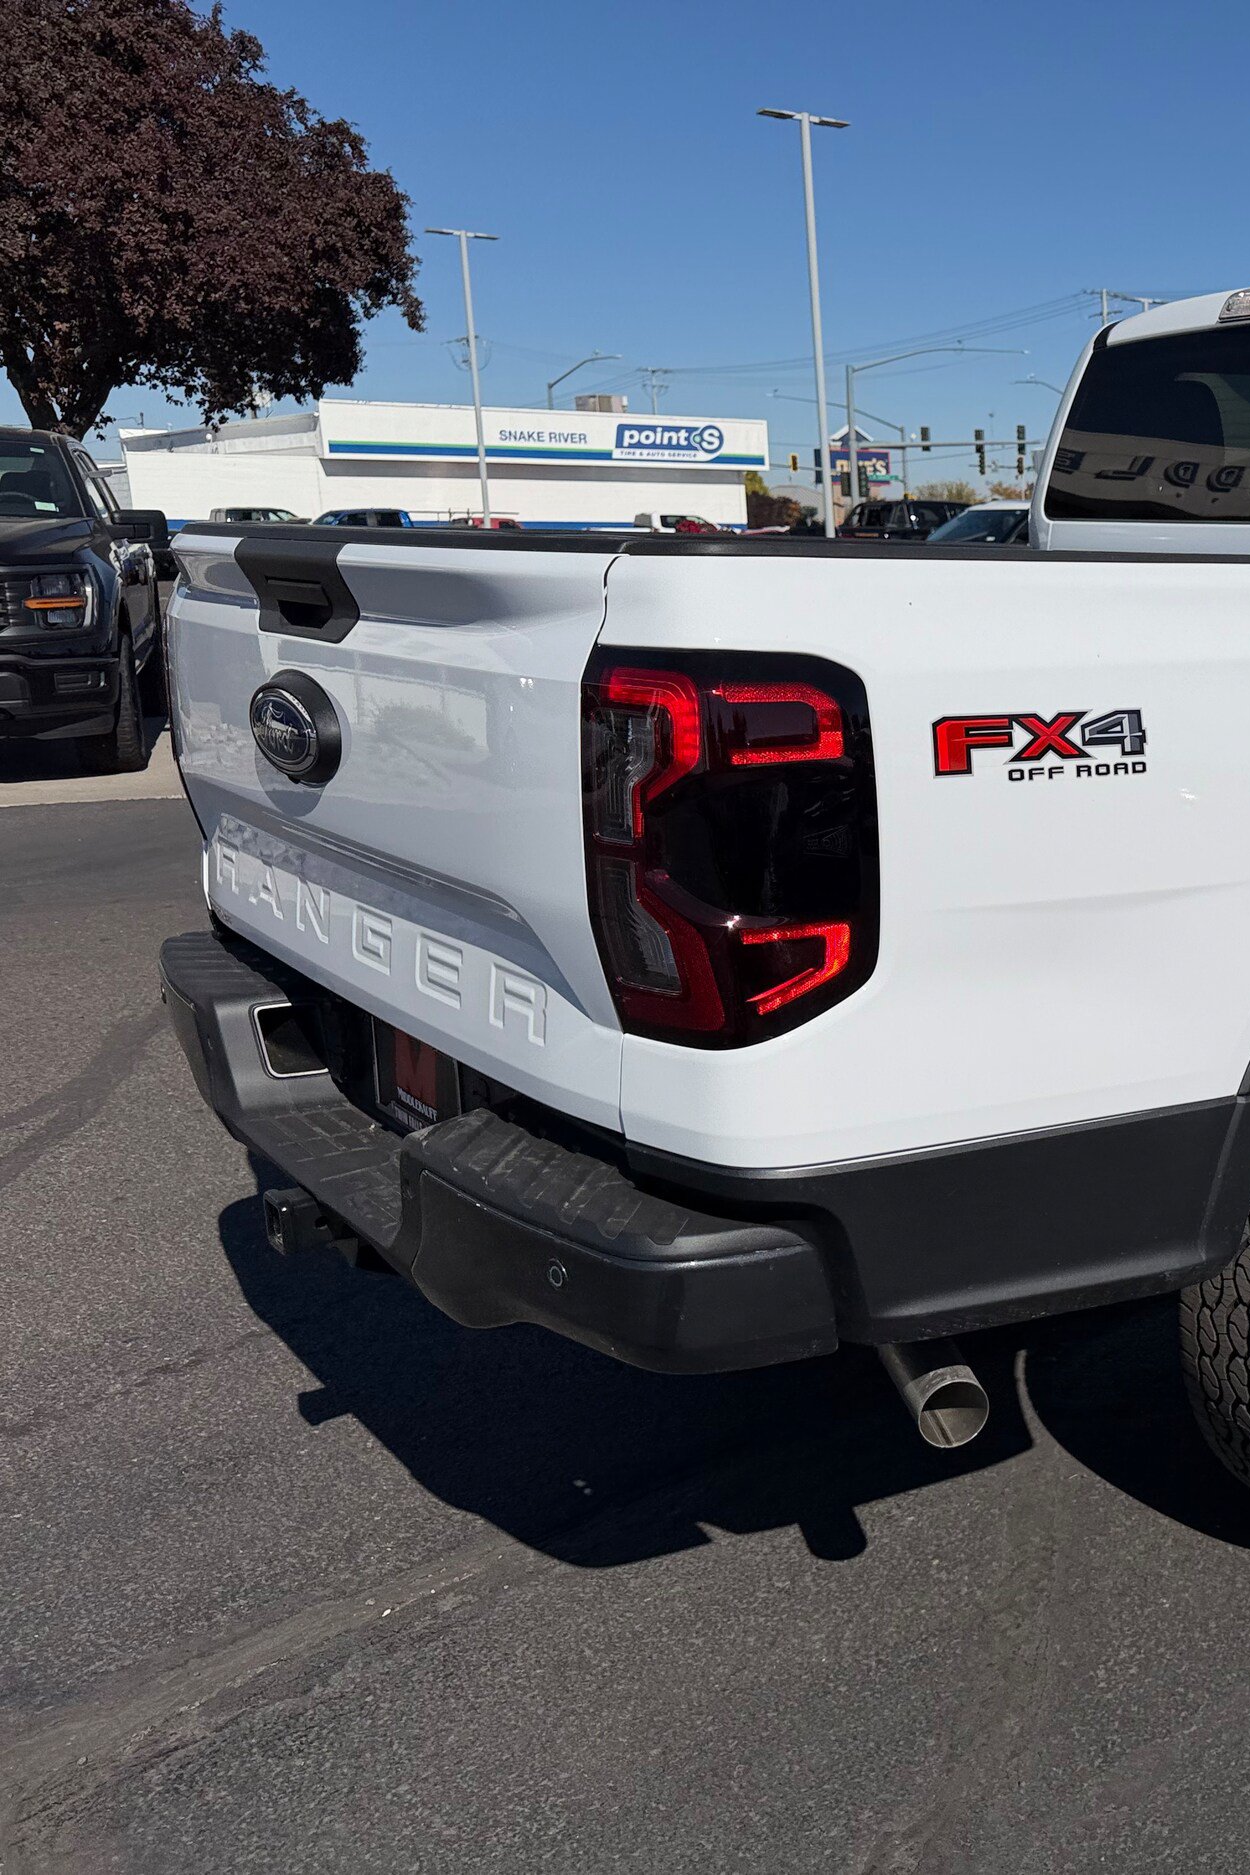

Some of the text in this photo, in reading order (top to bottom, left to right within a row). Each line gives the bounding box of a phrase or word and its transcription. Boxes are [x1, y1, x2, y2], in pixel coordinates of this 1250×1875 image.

[499, 429, 588, 445] SNAKE RIVER
[622, 427, 689, 447] point
[931, 708, 1147, 779] FX4
[1008, 761, 1147, 782] OFF ROAD
[216, 836, 547, 1047] RANGER
